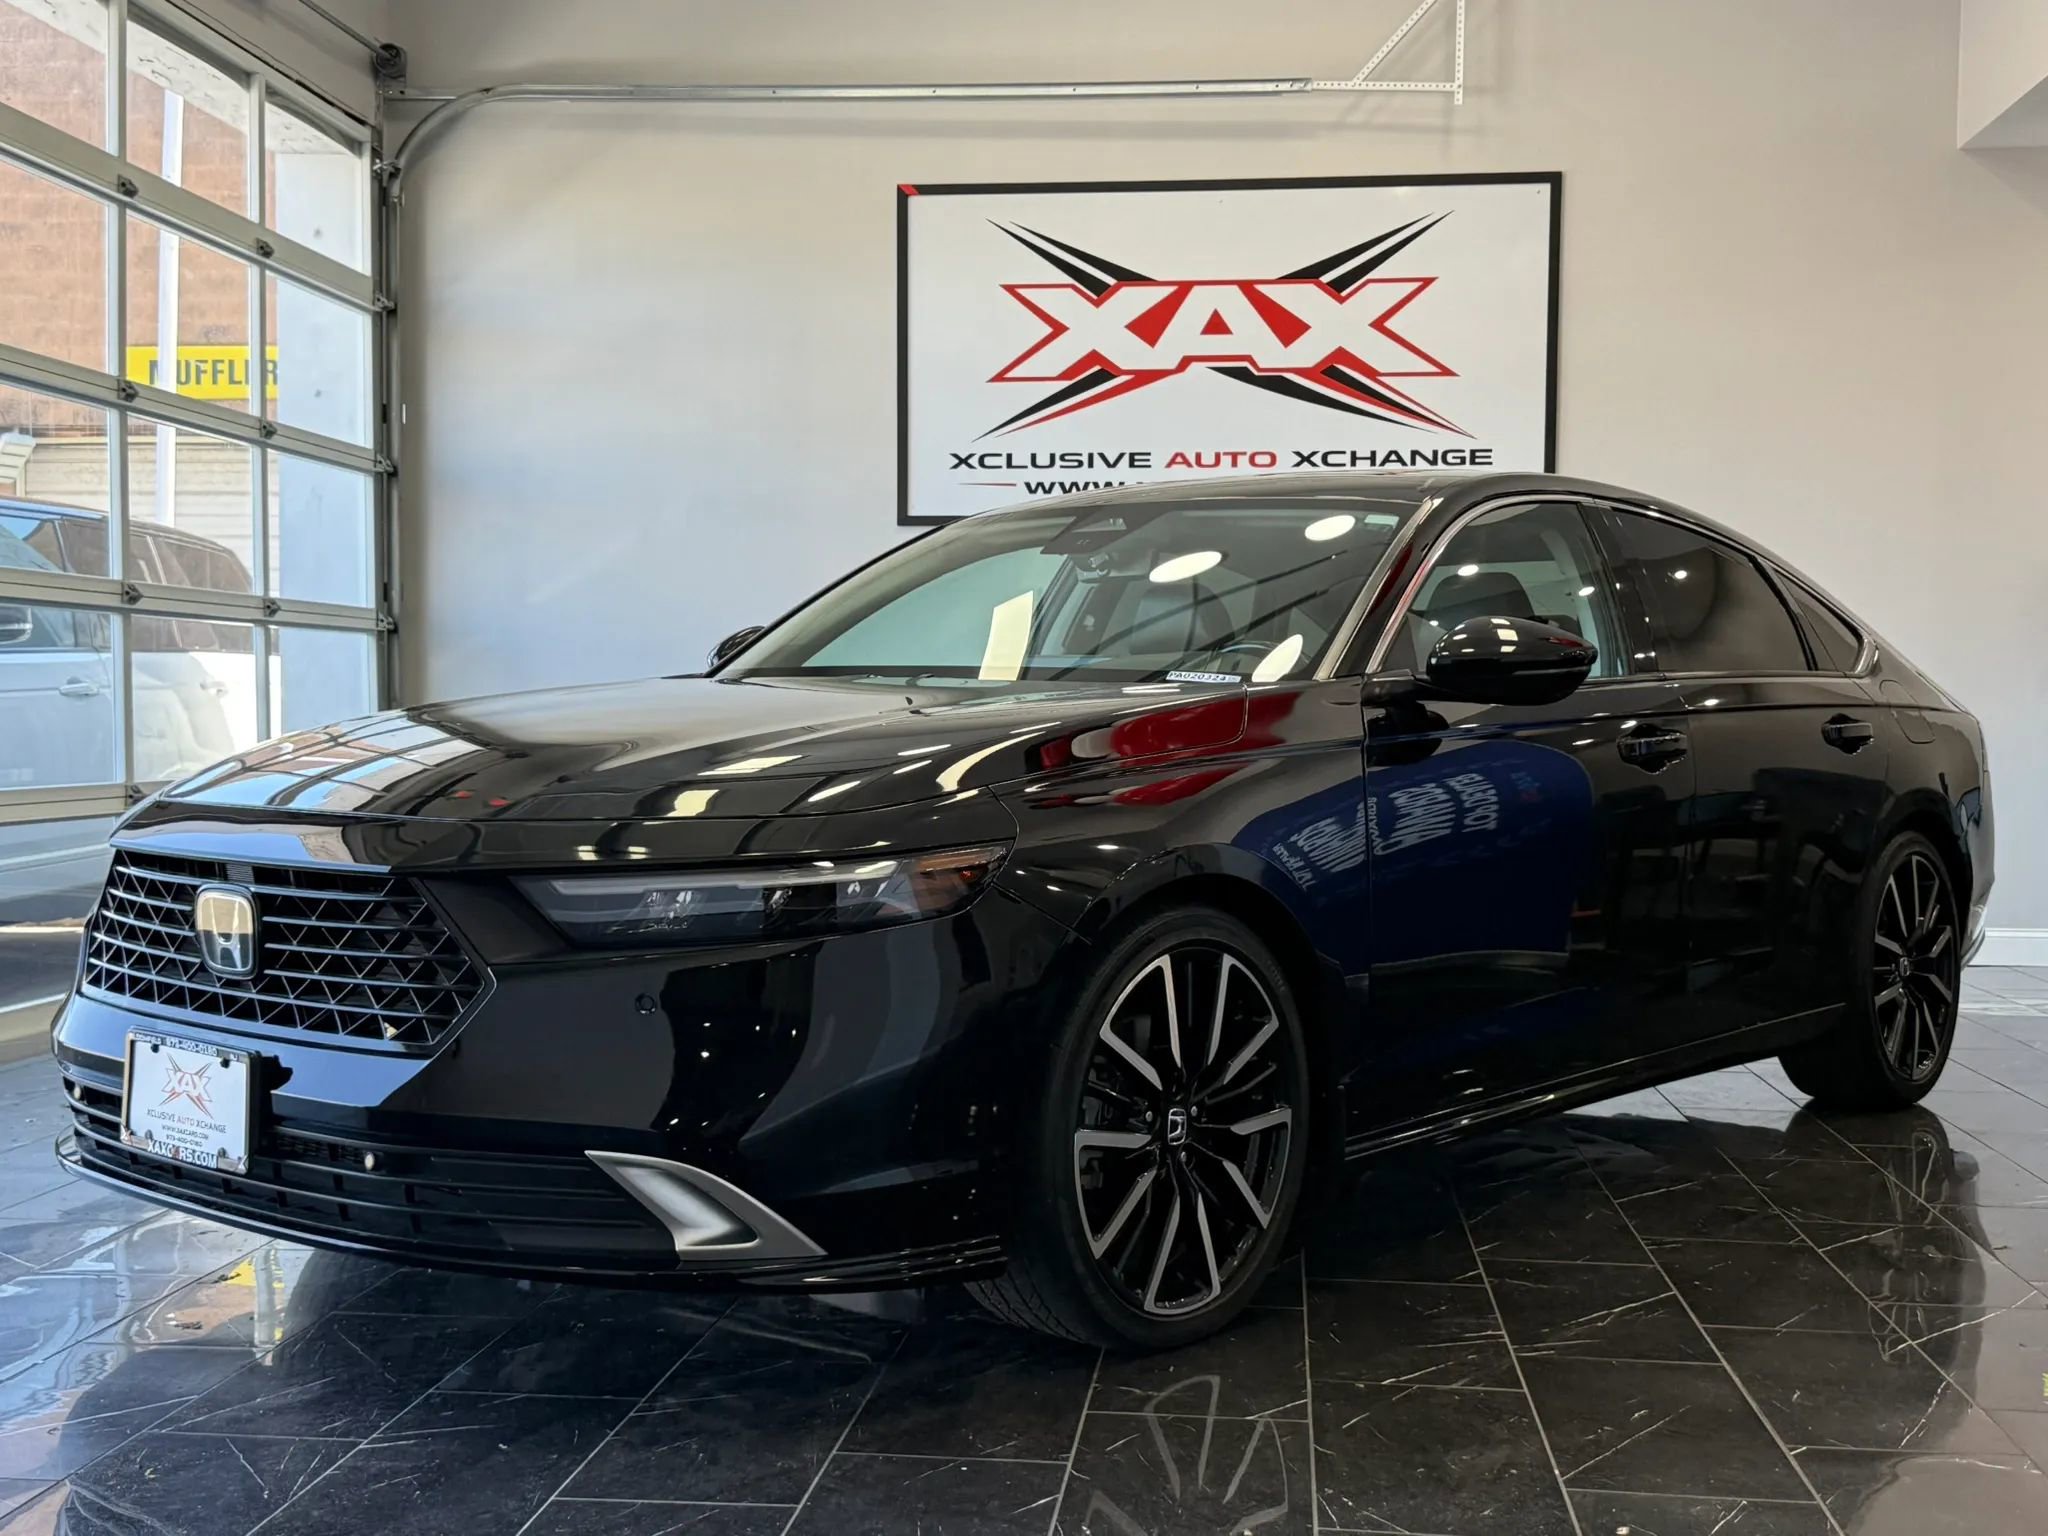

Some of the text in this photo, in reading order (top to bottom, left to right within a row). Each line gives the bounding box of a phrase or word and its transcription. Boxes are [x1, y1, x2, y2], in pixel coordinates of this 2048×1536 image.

[948, 448, 1494, 470] XCLUSIVE AUTO XCHANGE
[146, 1108, 227, 1134] XCLUSIVE AUTO XCHANGE
[147, 1139, 218, 1169] XAXCARS.COM
